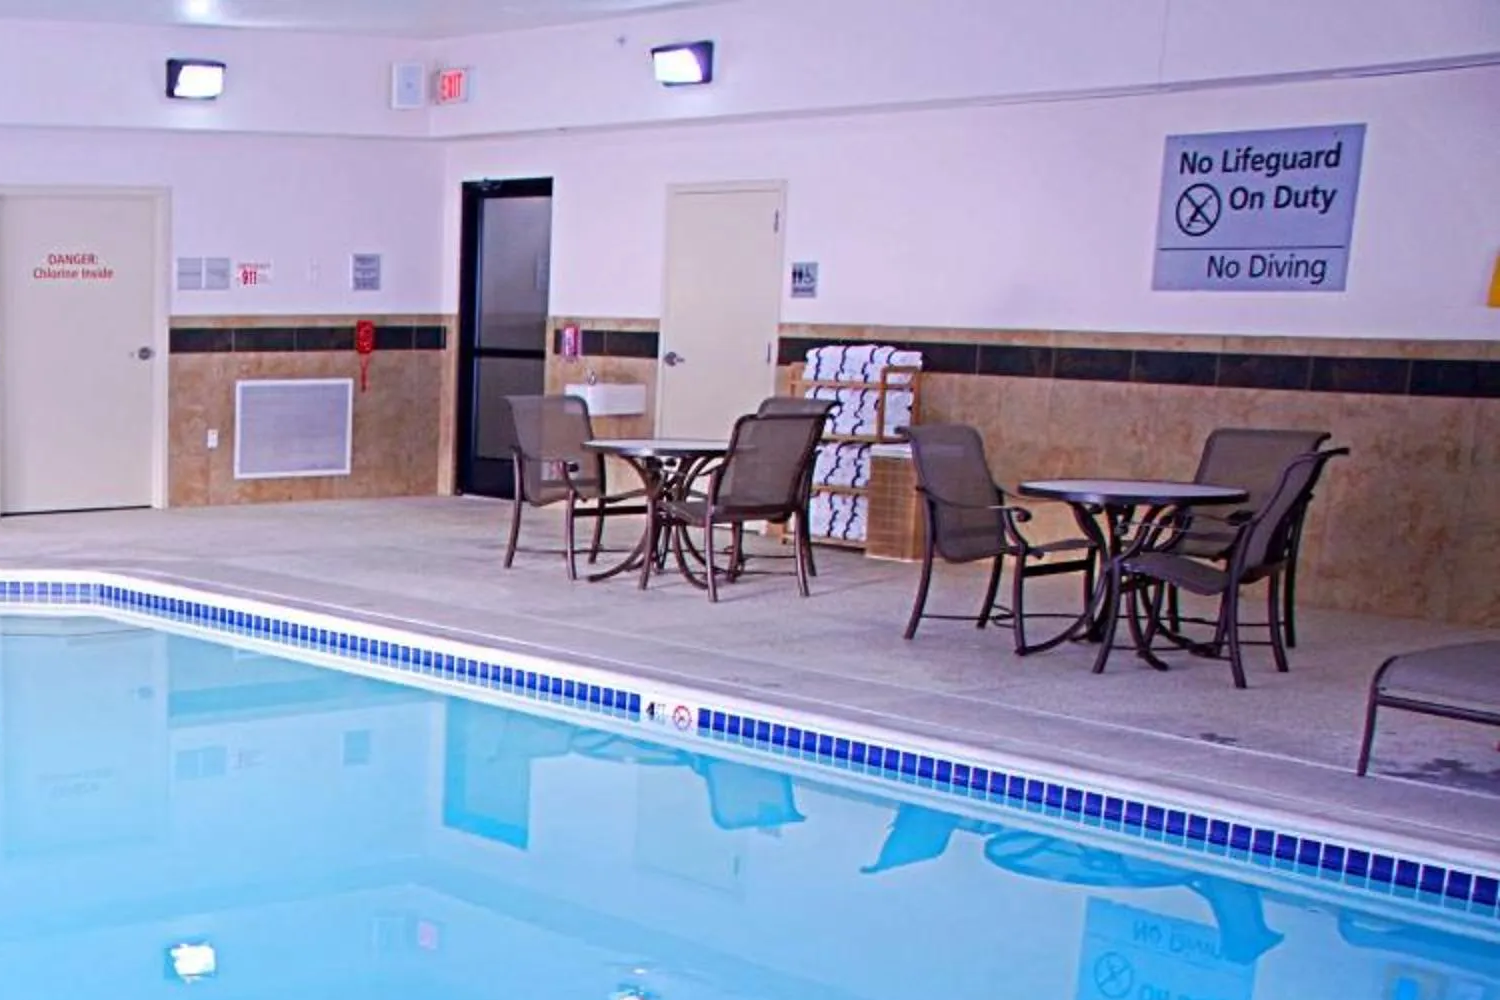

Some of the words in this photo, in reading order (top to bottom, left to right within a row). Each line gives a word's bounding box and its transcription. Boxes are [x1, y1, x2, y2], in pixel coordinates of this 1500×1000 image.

[441, 72, 463, 102] EXIT
[1179, 150, 1213, 175] No
[1221, 141, 1343, 177] Lifeguard
[1228, 185, 1265, 210] On
[1273, 184, 1338, 214] Duty
[33, 267, 79, 279] Chlorine
[81, 266, 114, 279] Inside
[242, 270, 257, 285] 911
[1206, 254, 1241, 279] No
[1248, 253, 1328, 285] Diving
[646, 701, 655, 720] 4
